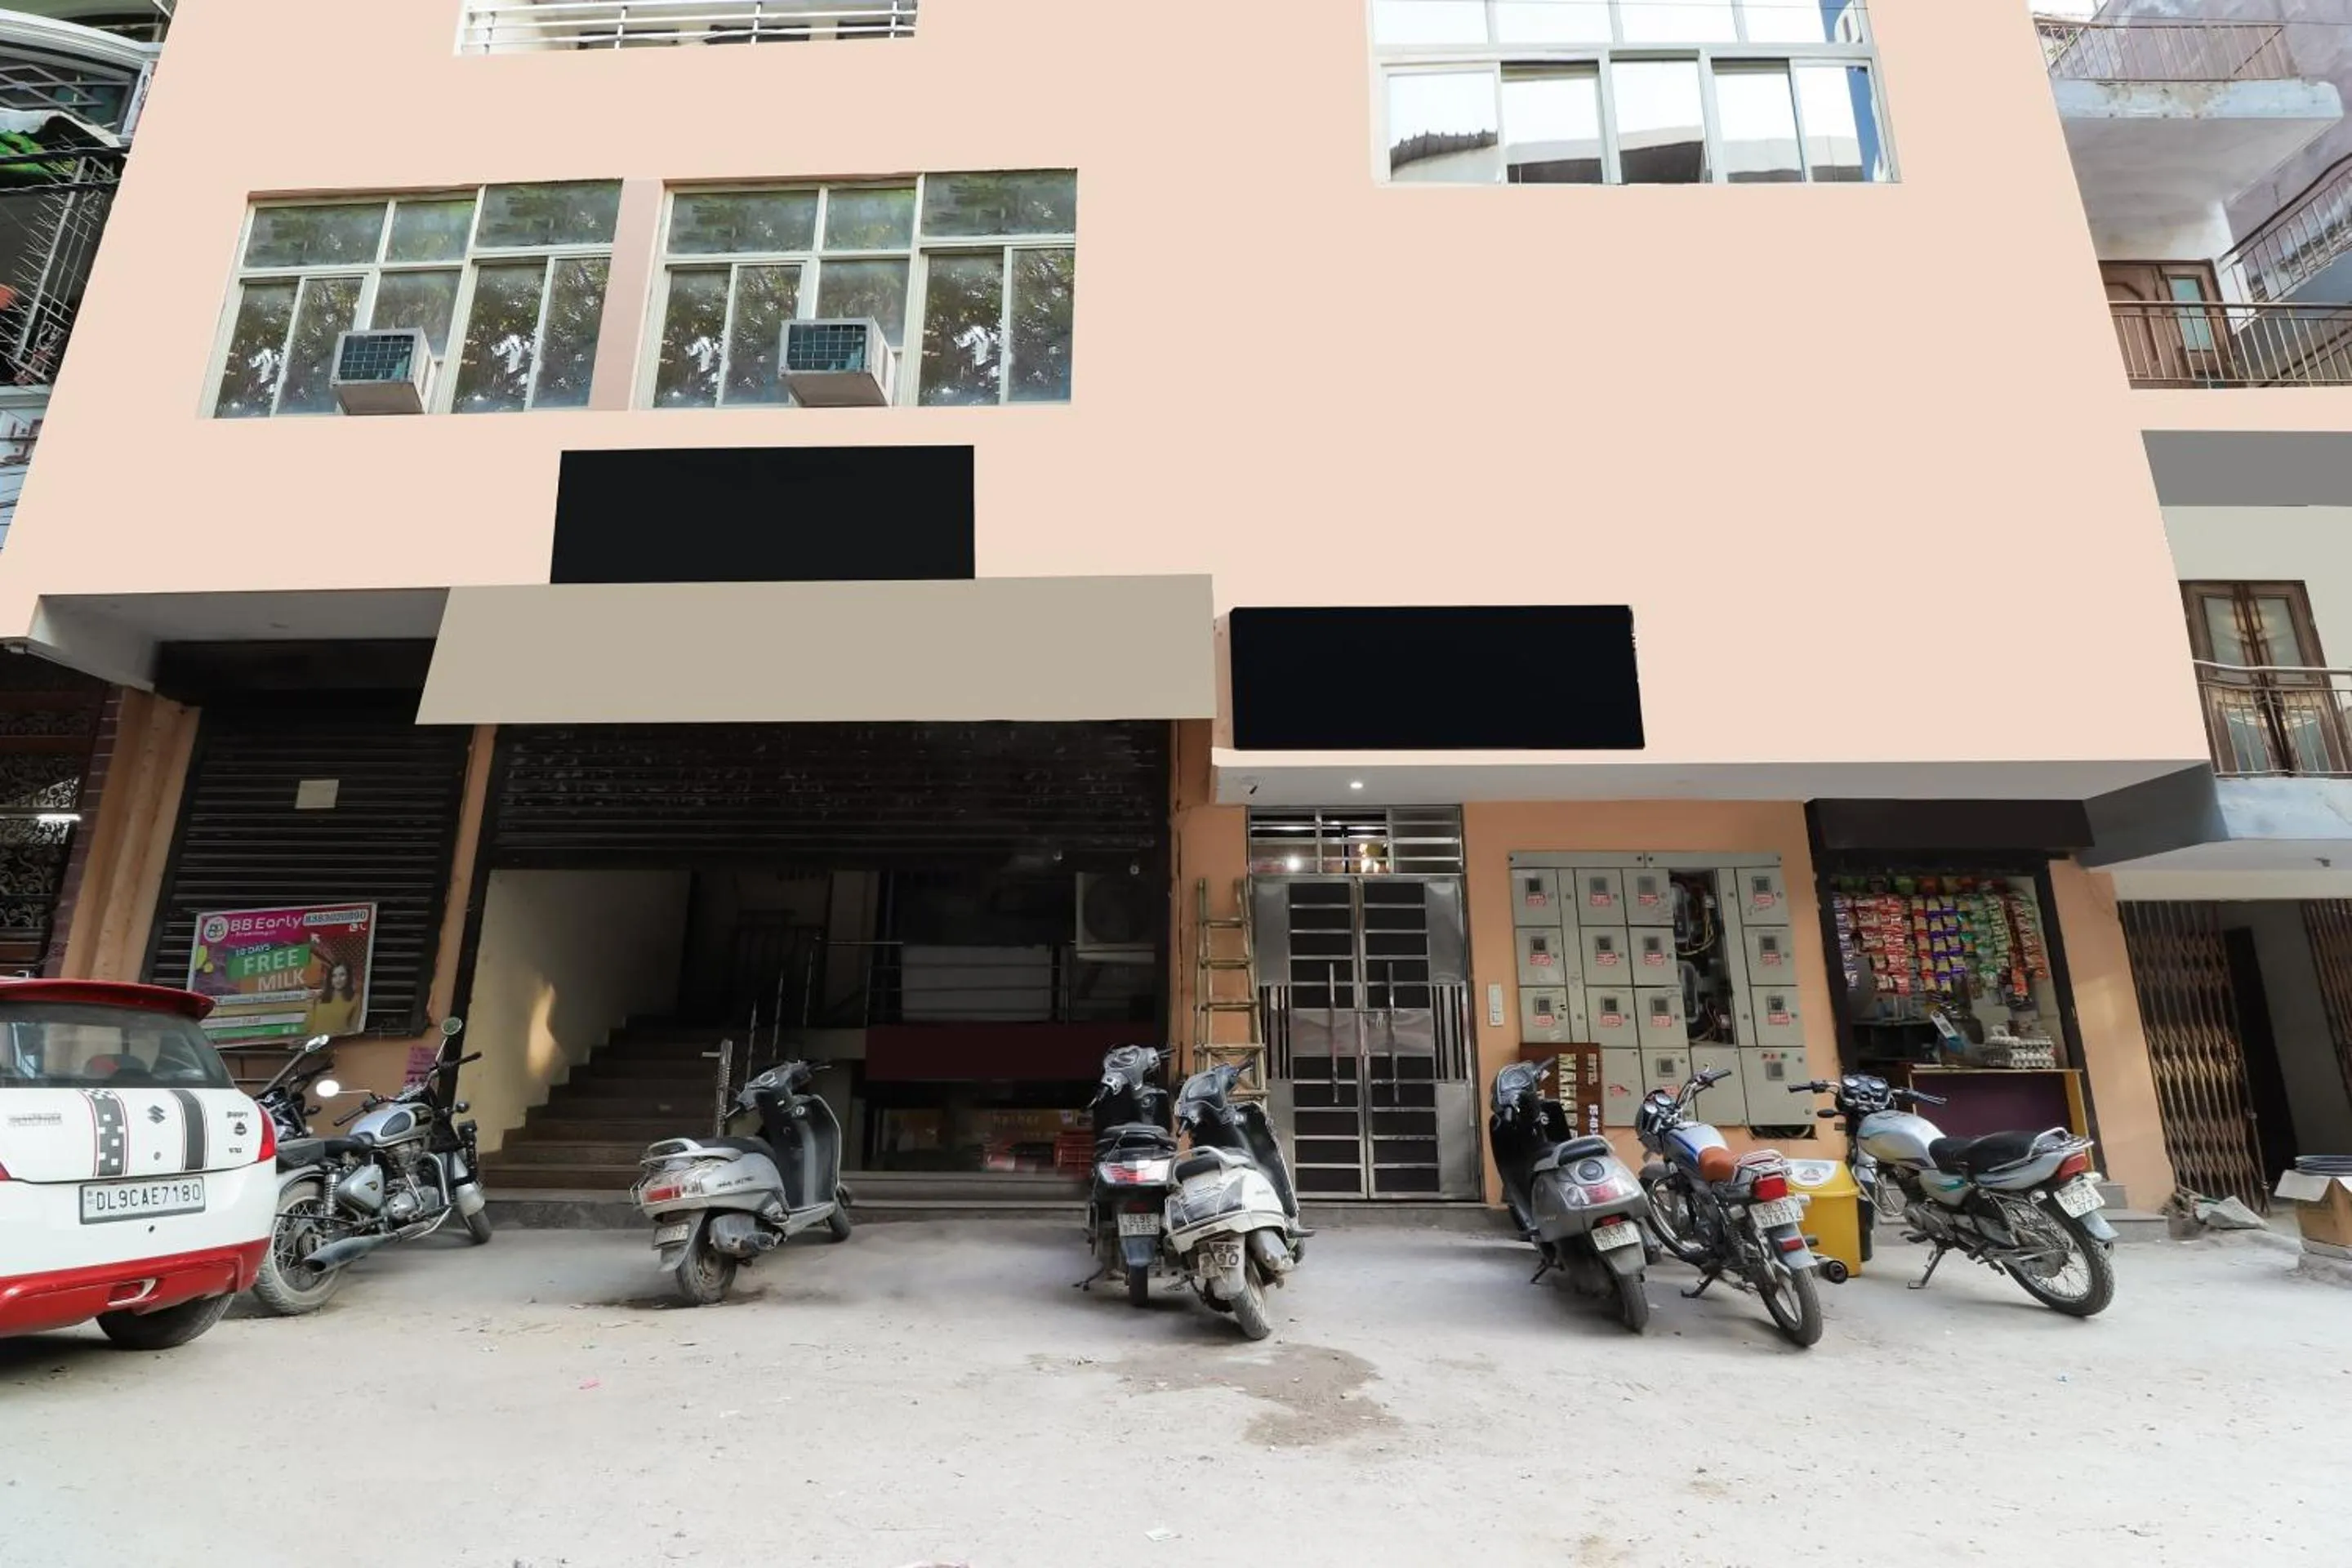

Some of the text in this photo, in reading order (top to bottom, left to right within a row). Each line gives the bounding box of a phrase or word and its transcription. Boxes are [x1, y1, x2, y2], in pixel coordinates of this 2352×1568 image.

[229, 915, 302, 933] BB Early
[243, 948, 300, 975] FREE
[258, 969, 305, 991] MILK
[96, 1183, 202, 1211] DL9CAE7180
